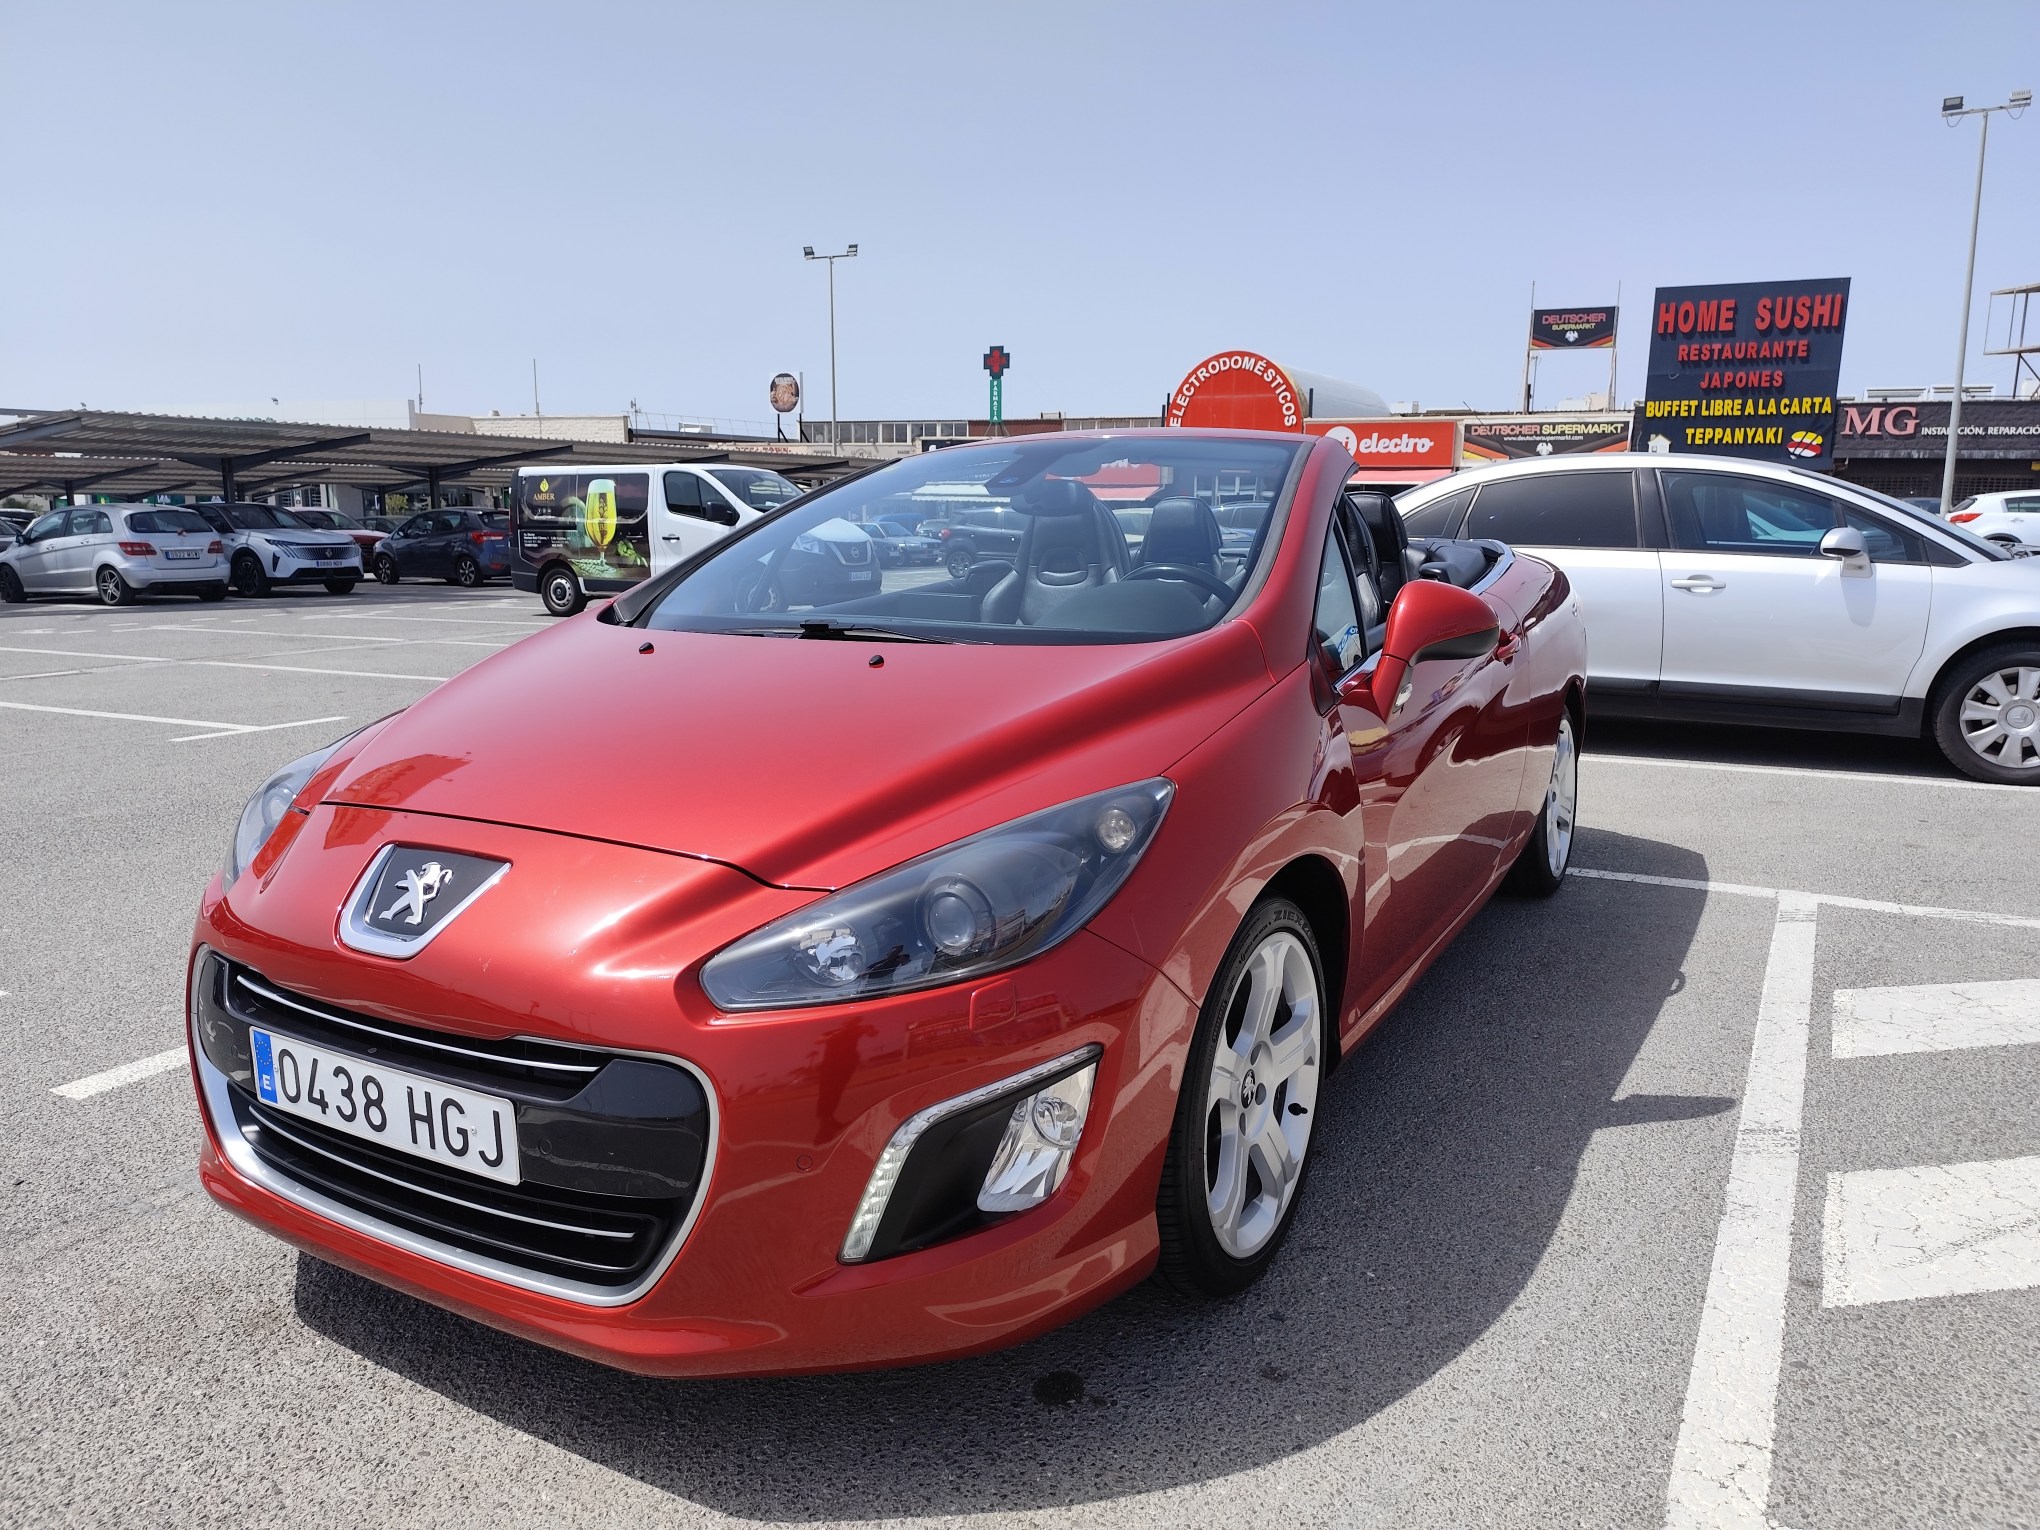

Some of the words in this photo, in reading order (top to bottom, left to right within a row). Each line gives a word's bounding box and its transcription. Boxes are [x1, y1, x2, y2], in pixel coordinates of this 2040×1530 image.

[1542, 312, 1606, 324] DEUTSCHER
[1657, 299, 1736, 334] HOME
[1755, 293, 1844, 331] SUSHI
[1552, 323, 1596, 331] SUPERMARKT
[1677, 340, 1808, 362] RESTAURANTE
[1700, 370, 1784, 390] JAPONES
[1169, 355, 1297, 427] ELECTRODOMÉSTICOS
[1646, 399, 1698, 417] BUFFET
[1701, 398, 1742, 416] LIBRE
[1744, 398, 1755, 416] A
[1757, 398, 1777, 416] LA
[1780, 396, 1832, 415] CARTA
[1471, 424, 1540, 436] DEUTSCHER
[1541, 423, 1624, 434] SUPERMARKT
[1840, 406, 1920, 436] MG
[1359, 432, 1434, 453] electro
[1686, 427, 1783, 444] TEPPANYAKI
[533, 492, 555, 501] AMBER
[262, 1073, 272, 1091] E
[277, 1048, 388, 1133] 0438
[406, 1085, 504, 1168] HGJ
